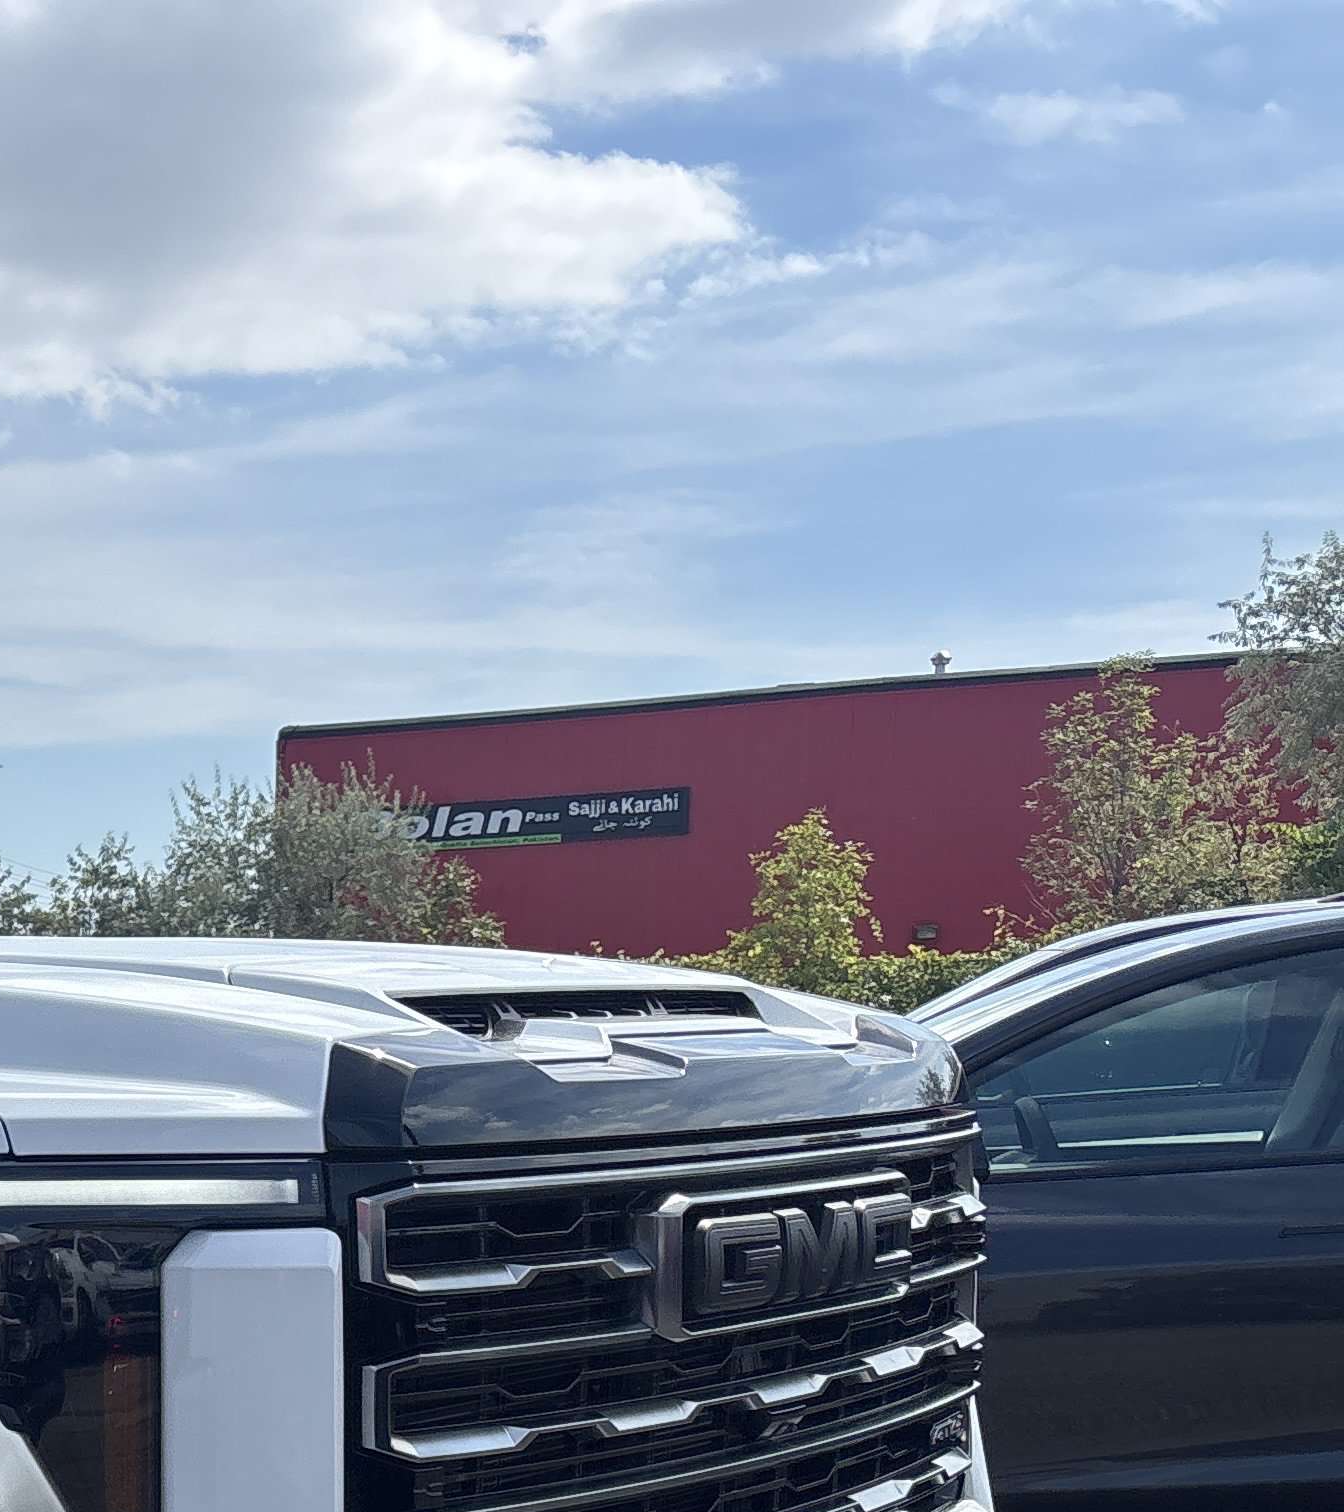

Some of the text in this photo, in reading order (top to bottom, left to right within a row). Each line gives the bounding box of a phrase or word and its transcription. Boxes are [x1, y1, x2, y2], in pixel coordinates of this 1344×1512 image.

[380, 806, 561, 839] olan Pass
[568, 793, 680, 819] Sajji & Karahi
[697, 1193, 912, 1312] GMC
